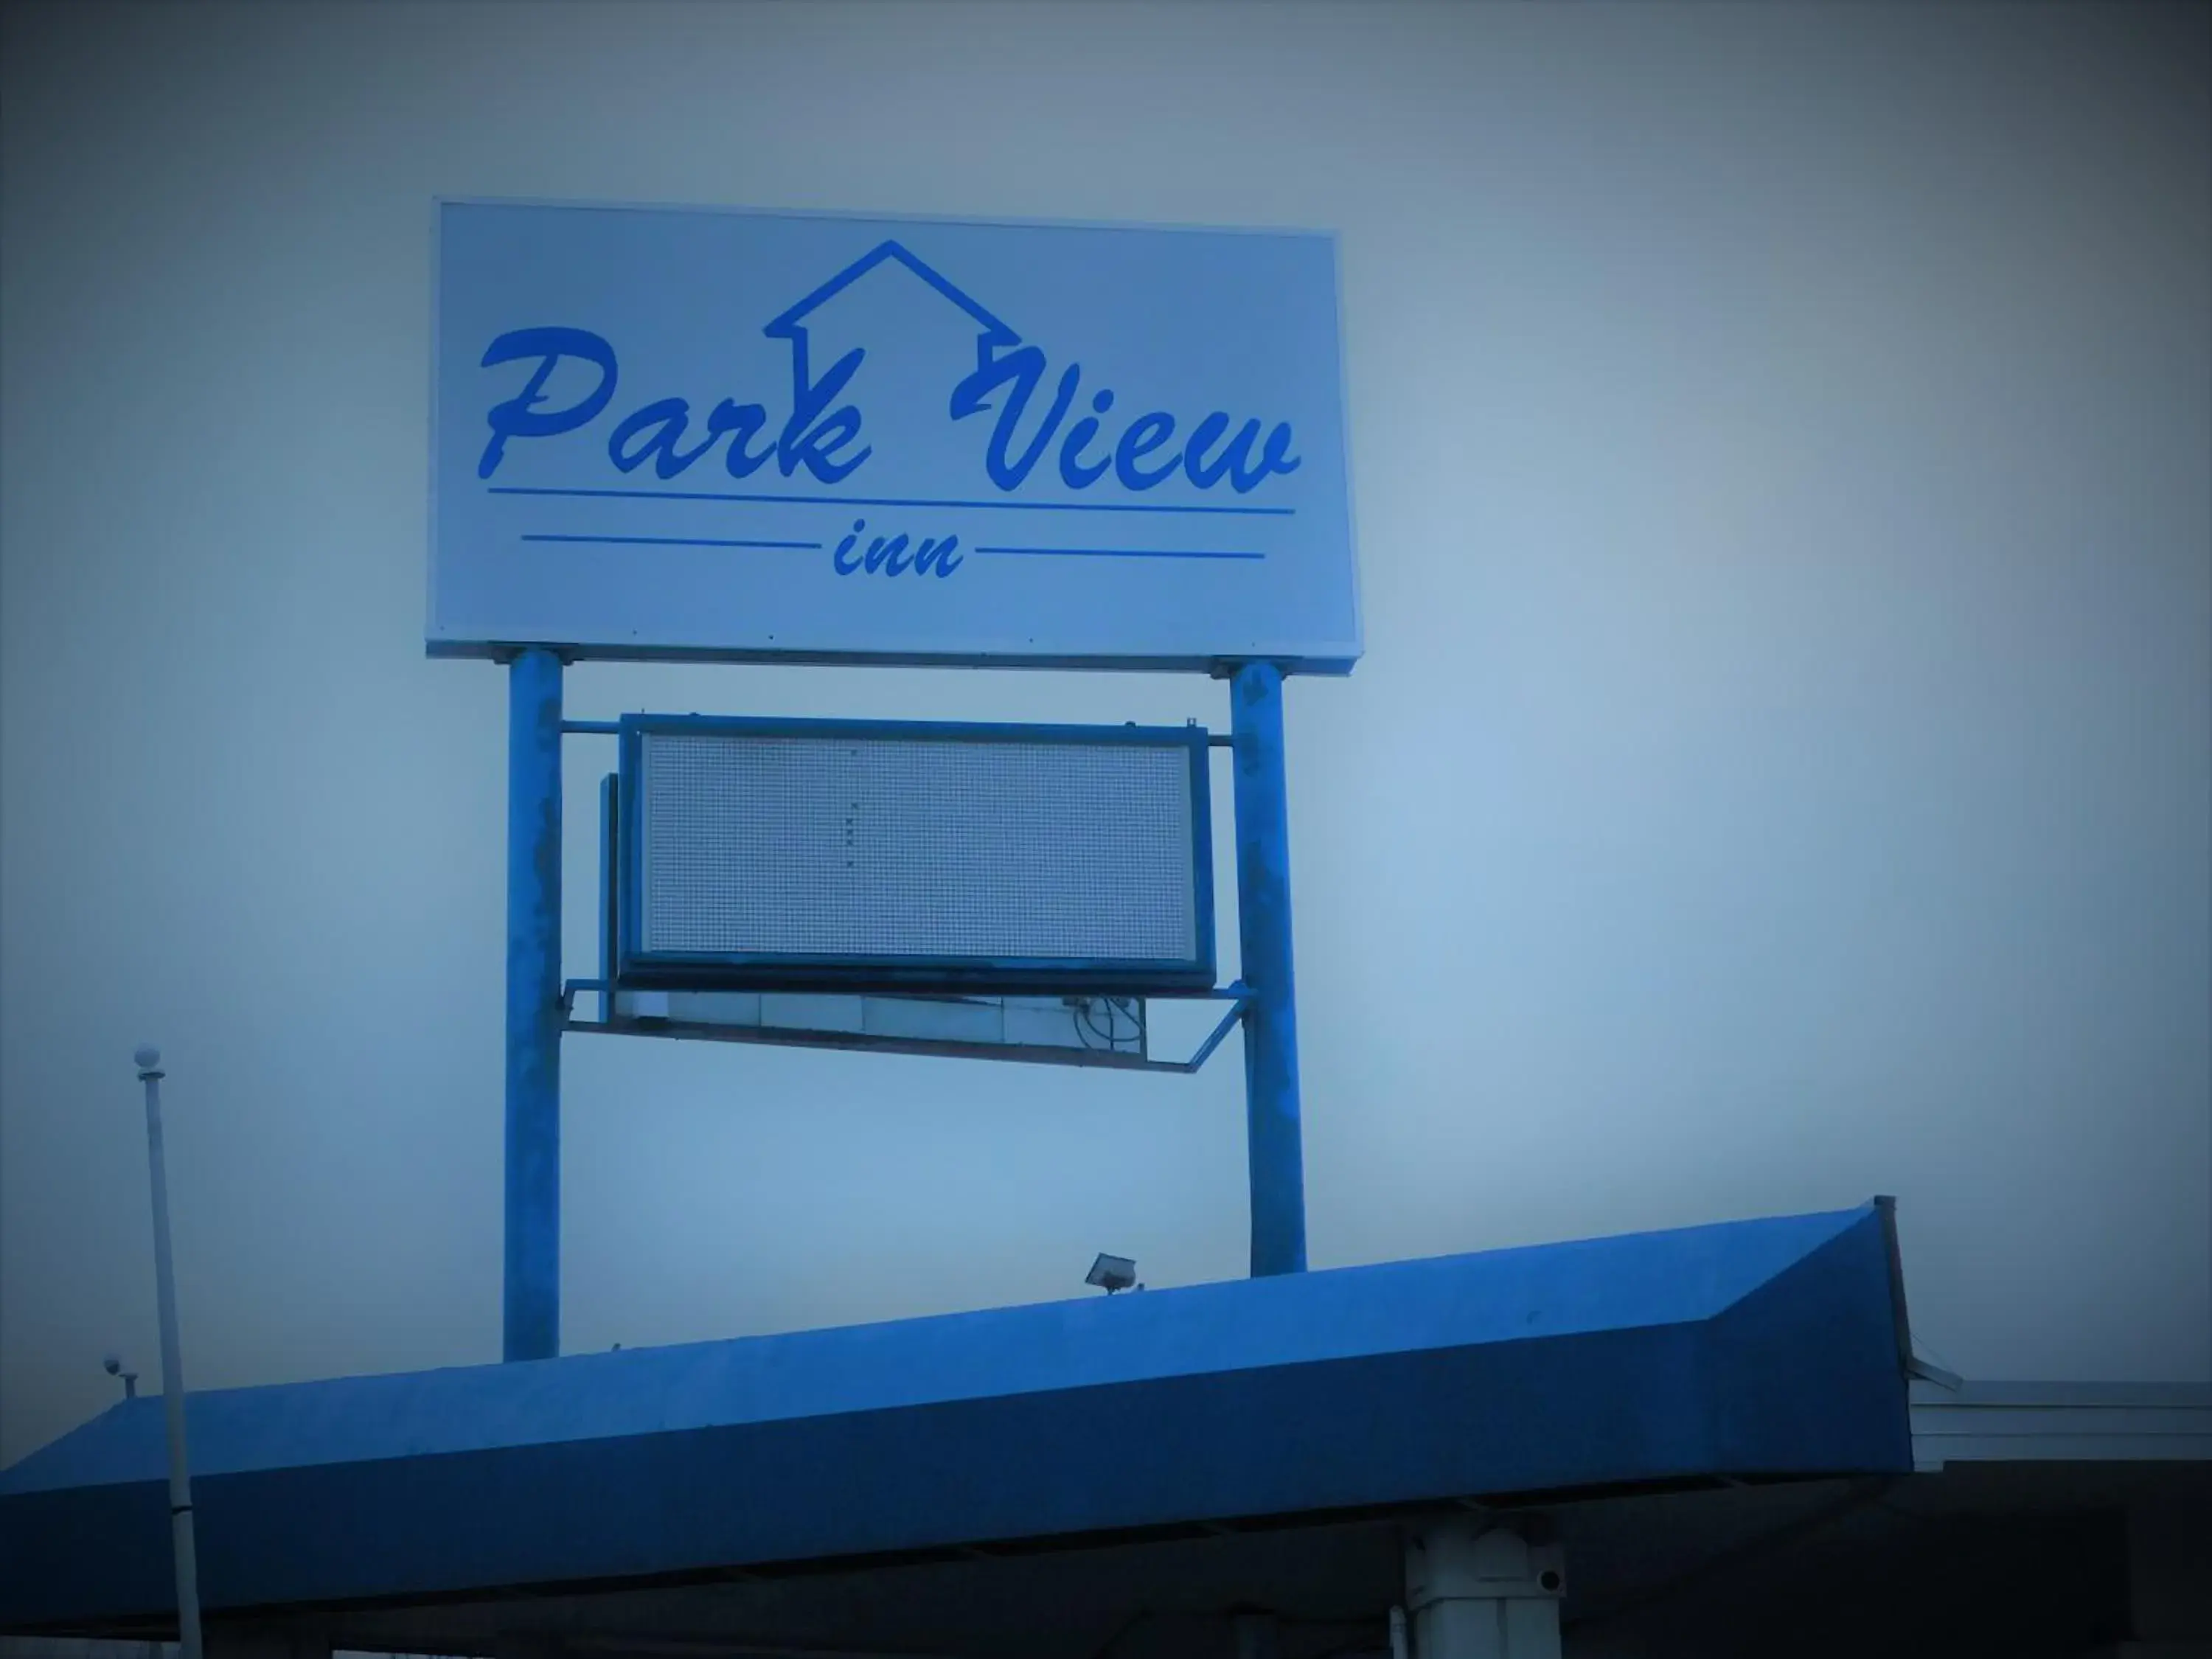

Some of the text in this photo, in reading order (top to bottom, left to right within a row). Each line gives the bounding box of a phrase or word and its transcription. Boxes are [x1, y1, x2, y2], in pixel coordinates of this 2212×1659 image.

[478, 326, 1301, 493] Park View
[833, 518, 963, 578] inn
